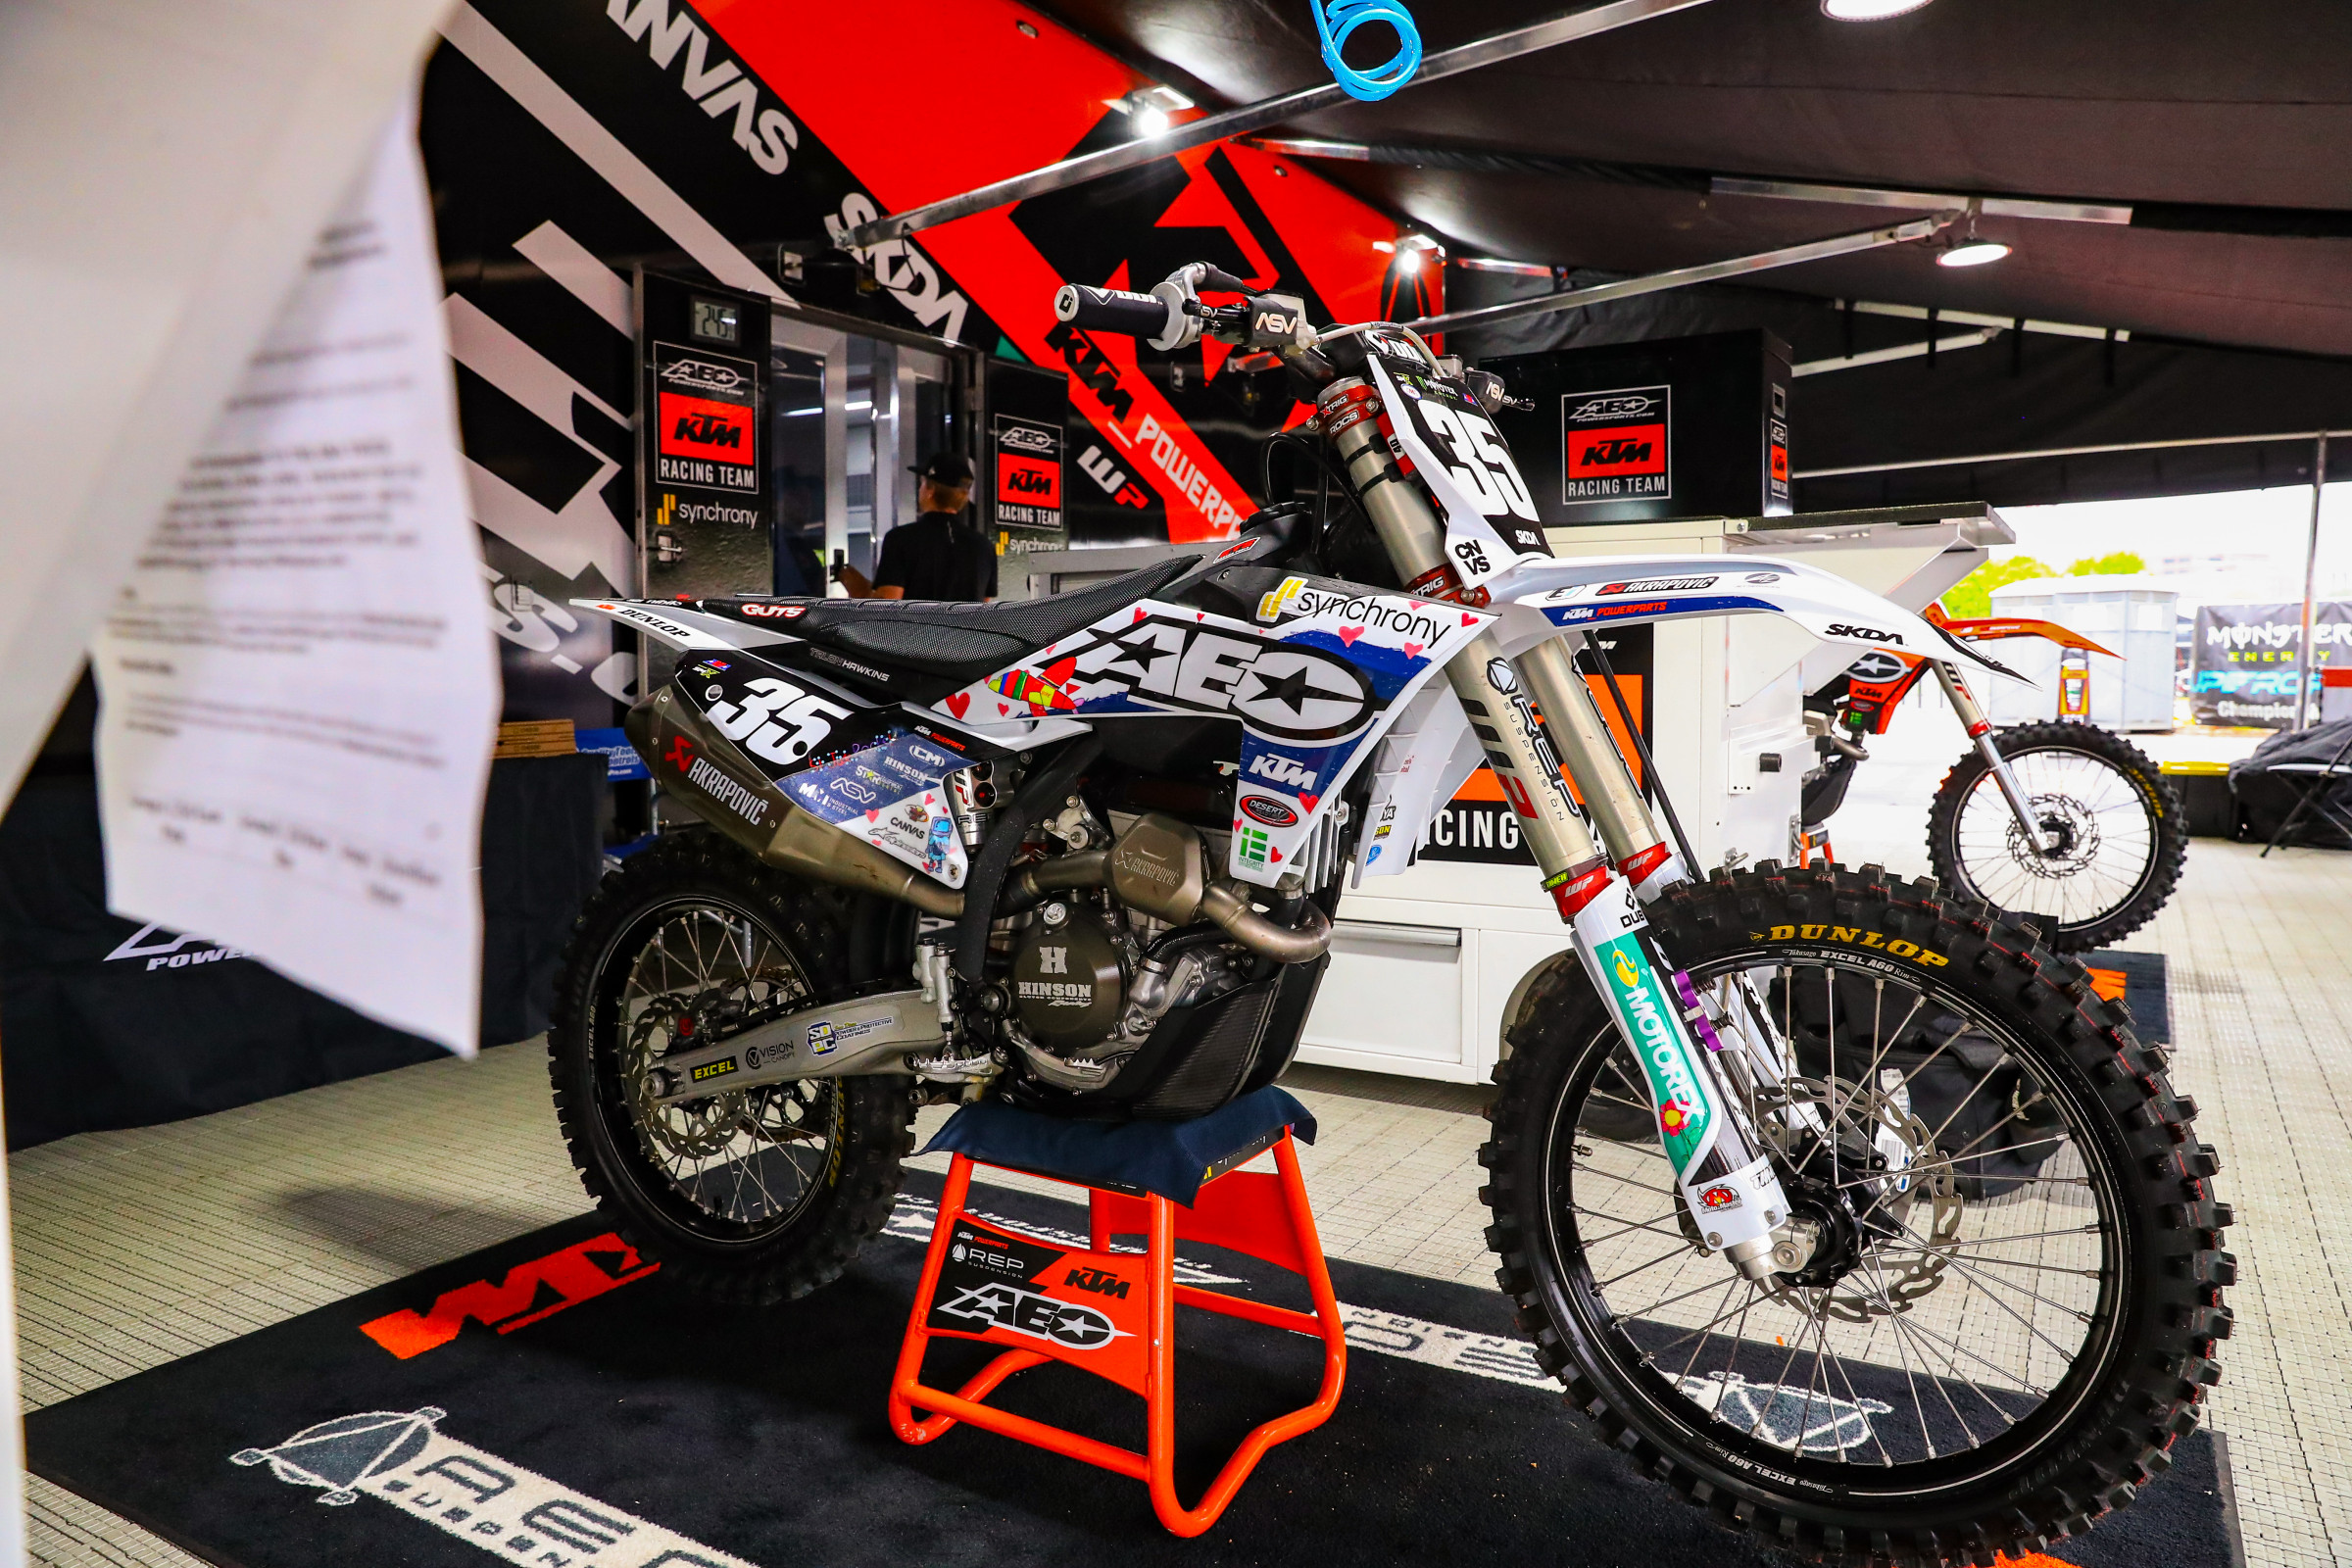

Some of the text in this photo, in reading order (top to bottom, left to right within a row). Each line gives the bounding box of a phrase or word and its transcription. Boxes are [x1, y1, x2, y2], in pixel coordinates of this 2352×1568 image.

[606, 0, 799, 175] NVAS
[1255, 313, 1298, 334] ASV
[662, 359, 749, 388] AEO
[1044, 321, 1134, 423] KTM
[1486, 381, 1504, 401] ASV
[1322, 395, 1348, 417] XTRIG
[1569, 396, 1662, 419] AEO
[674, 413, 741, 448] KTM
[1330, 411, 1359, 435] ROCS
[1417, 399, 1540, 521] 35
[1580, 438, 1652, 466] KTM
[661, 459, 755, 489] RACING TEAM
[1007, 468, 1052, 495] KTM
[1077, 444, 1149, 509] WP
[1568, 475, 1665, 497] RACING TEAM
[678, 502, 759, 529] synchrony
[999, 504, 1060, 526] RACING TEAM
[1515, 529, 1539, 546] SKDA
[1453, 538, 1481, 562] CN
[1465, 554, 1492, 576] VS
[1409, 574, 1446, 598] TRIG
[742, 603, 807, 618] GUTS
[1297, 589, 1452, 649] synchrony
[1562, 601, 1668, 620] KTM POWERPARTS
[618, 609, 690, 637] DUNLOP
[1825, 623, 1904, 646] SKDA
[809, 647, 890, 682] TALON HAWKINS
[2228, 651, 2330, 662] ENERY
[1047, 614, 1370, 735] AEO
[1854, 687, 1883, 698] KTM
[709, 677, 855, 764] 35
[914, 725, 966, 752] KTM POWERPARTS
[1503, 701, 1565, 821] SUSPENSION
[1511, 695, 1581, 817] REP
[885, 756, 928, 782] HINSON
[1249, 752, 1318, 791] KTM
[830, 777, 877, 804] ASV
[829, 797, 859, 815] INDUSTRIAL
[1250, 800, 1285, 815] DESERT
[890, 816, 925, 840] CANVAS
[1434, 808, 1519, 851] CING
[1628, 851, 1653, 871] WP
[1564, 875, 1593, 898] WP
[1769, 924, 1949, 967] DUNLOP
[1782, 949, 1911, 979] Takasago EXCEL A60 Rim
[1018, 981, 1092, 998] HINSON
[760, 1040, 795, 1059] VISION
[770, 1052, 795, 1064] CANOPY
[1625, 986, 1706, 1125] MOTOREX
[694, 1060, 735, 1080] EXCEL
[957, 1231, 1009, 1250] KTM POWERPARTS
[968, 1248, 1024, 1269] REP
[1063, 1266, 1131, 1300] KTM
[936, 1282, 1125, 1350] AEO
[1727, 1454, 1754, 1470] A60
[1754, 1465, 1797, 1487] EXCEL
